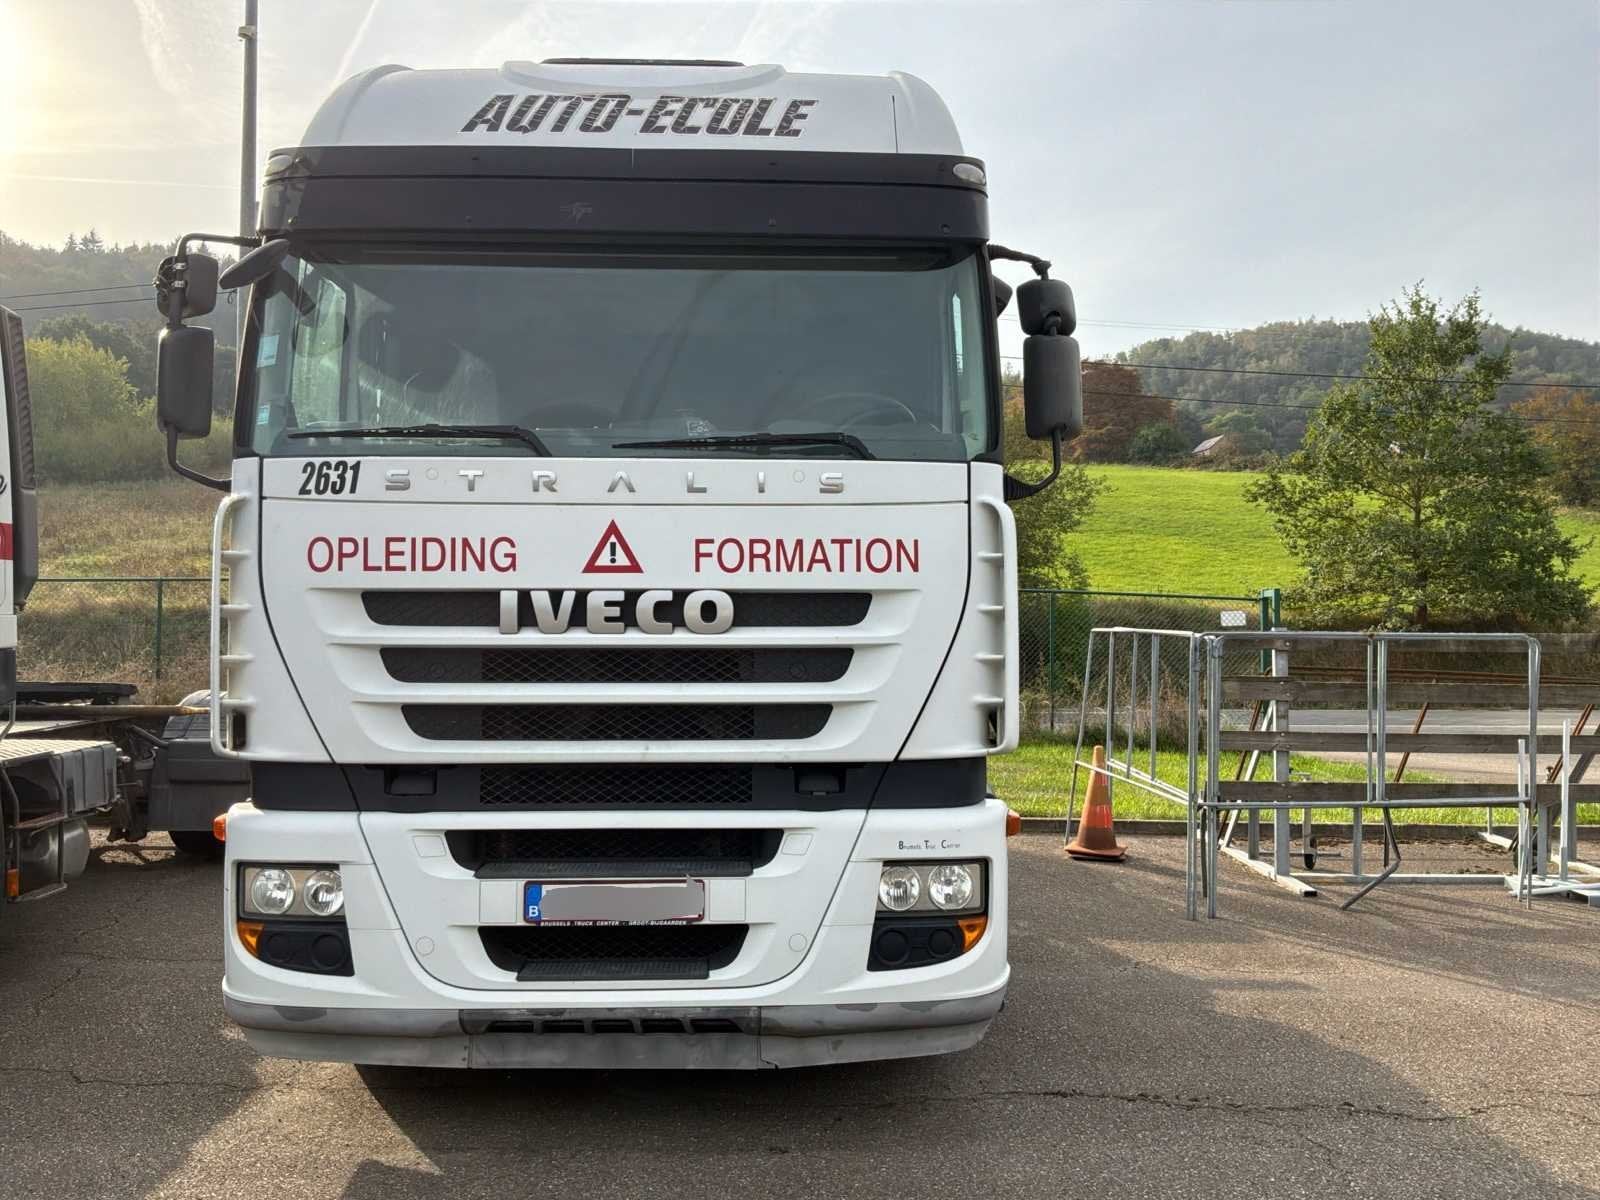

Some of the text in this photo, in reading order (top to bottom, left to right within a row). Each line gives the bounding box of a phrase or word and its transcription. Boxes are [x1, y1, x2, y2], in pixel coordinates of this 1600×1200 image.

[460, 94, 819, 138] AUTO-ECOLE
[298, 460, 361, 496] 2631
[384, 468, 845, 495] STRALIS
[307, 536, 920, 574] OPLEIDING FORMATION
[499, 589, 735, 635] IVECO
[528, 905, 539, 918] B
